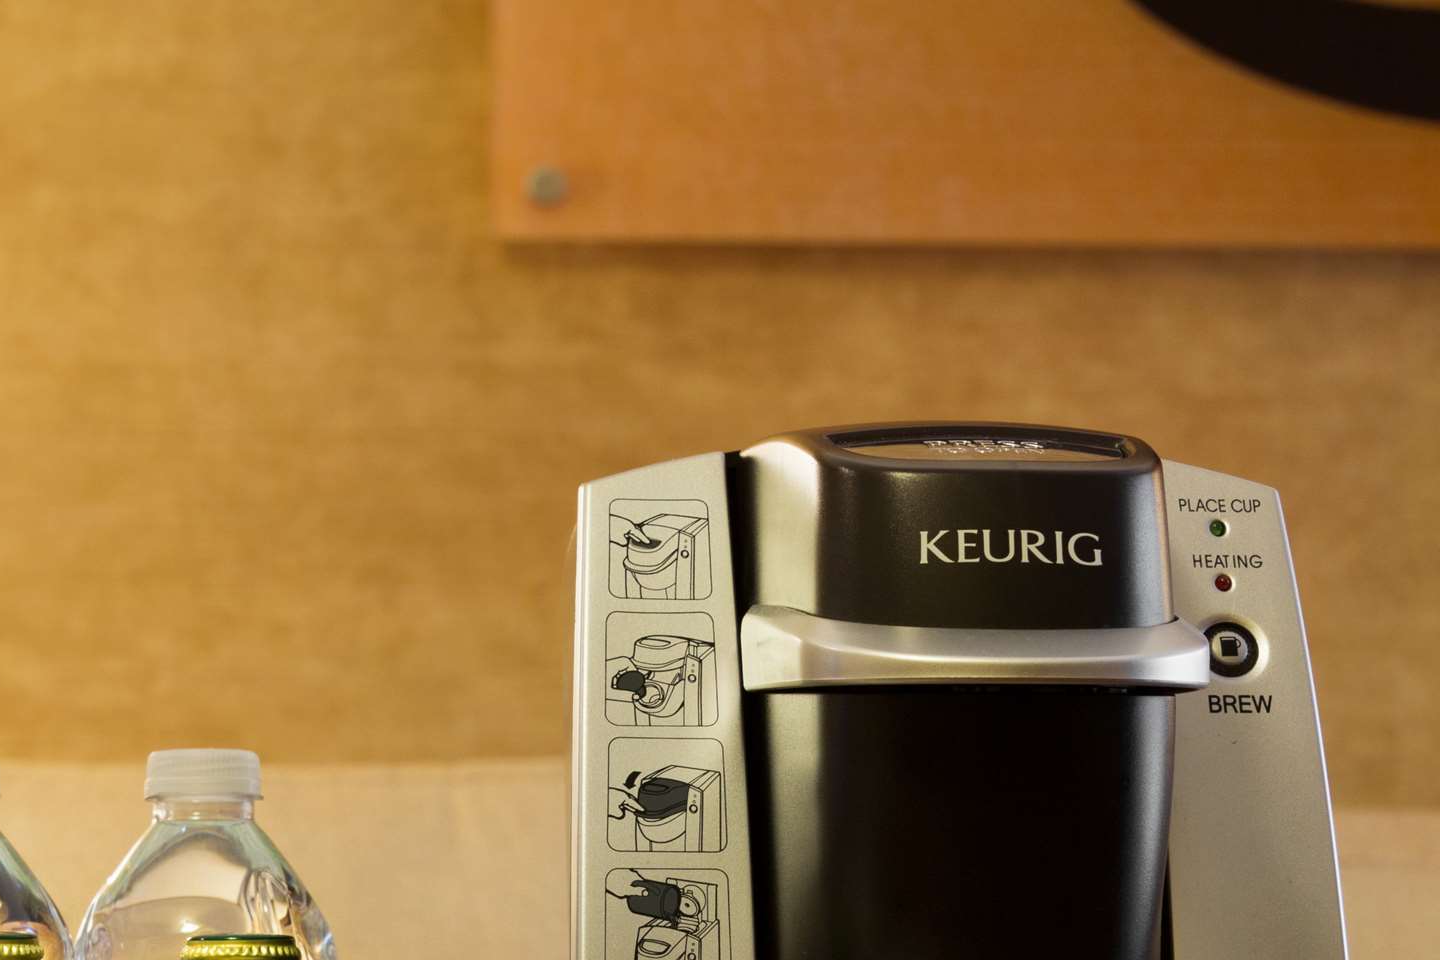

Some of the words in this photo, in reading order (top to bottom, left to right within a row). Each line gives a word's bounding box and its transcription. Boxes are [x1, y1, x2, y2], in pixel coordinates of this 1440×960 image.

[1177, 498, 1227, 513] PLACE
[1230, 498, 1262, 514] CUP
[917, 528, 1104, 567] KEURIG
[1192, 553, 1264, 569] HEATING
[1207, 694, 1273, 715] BREW
